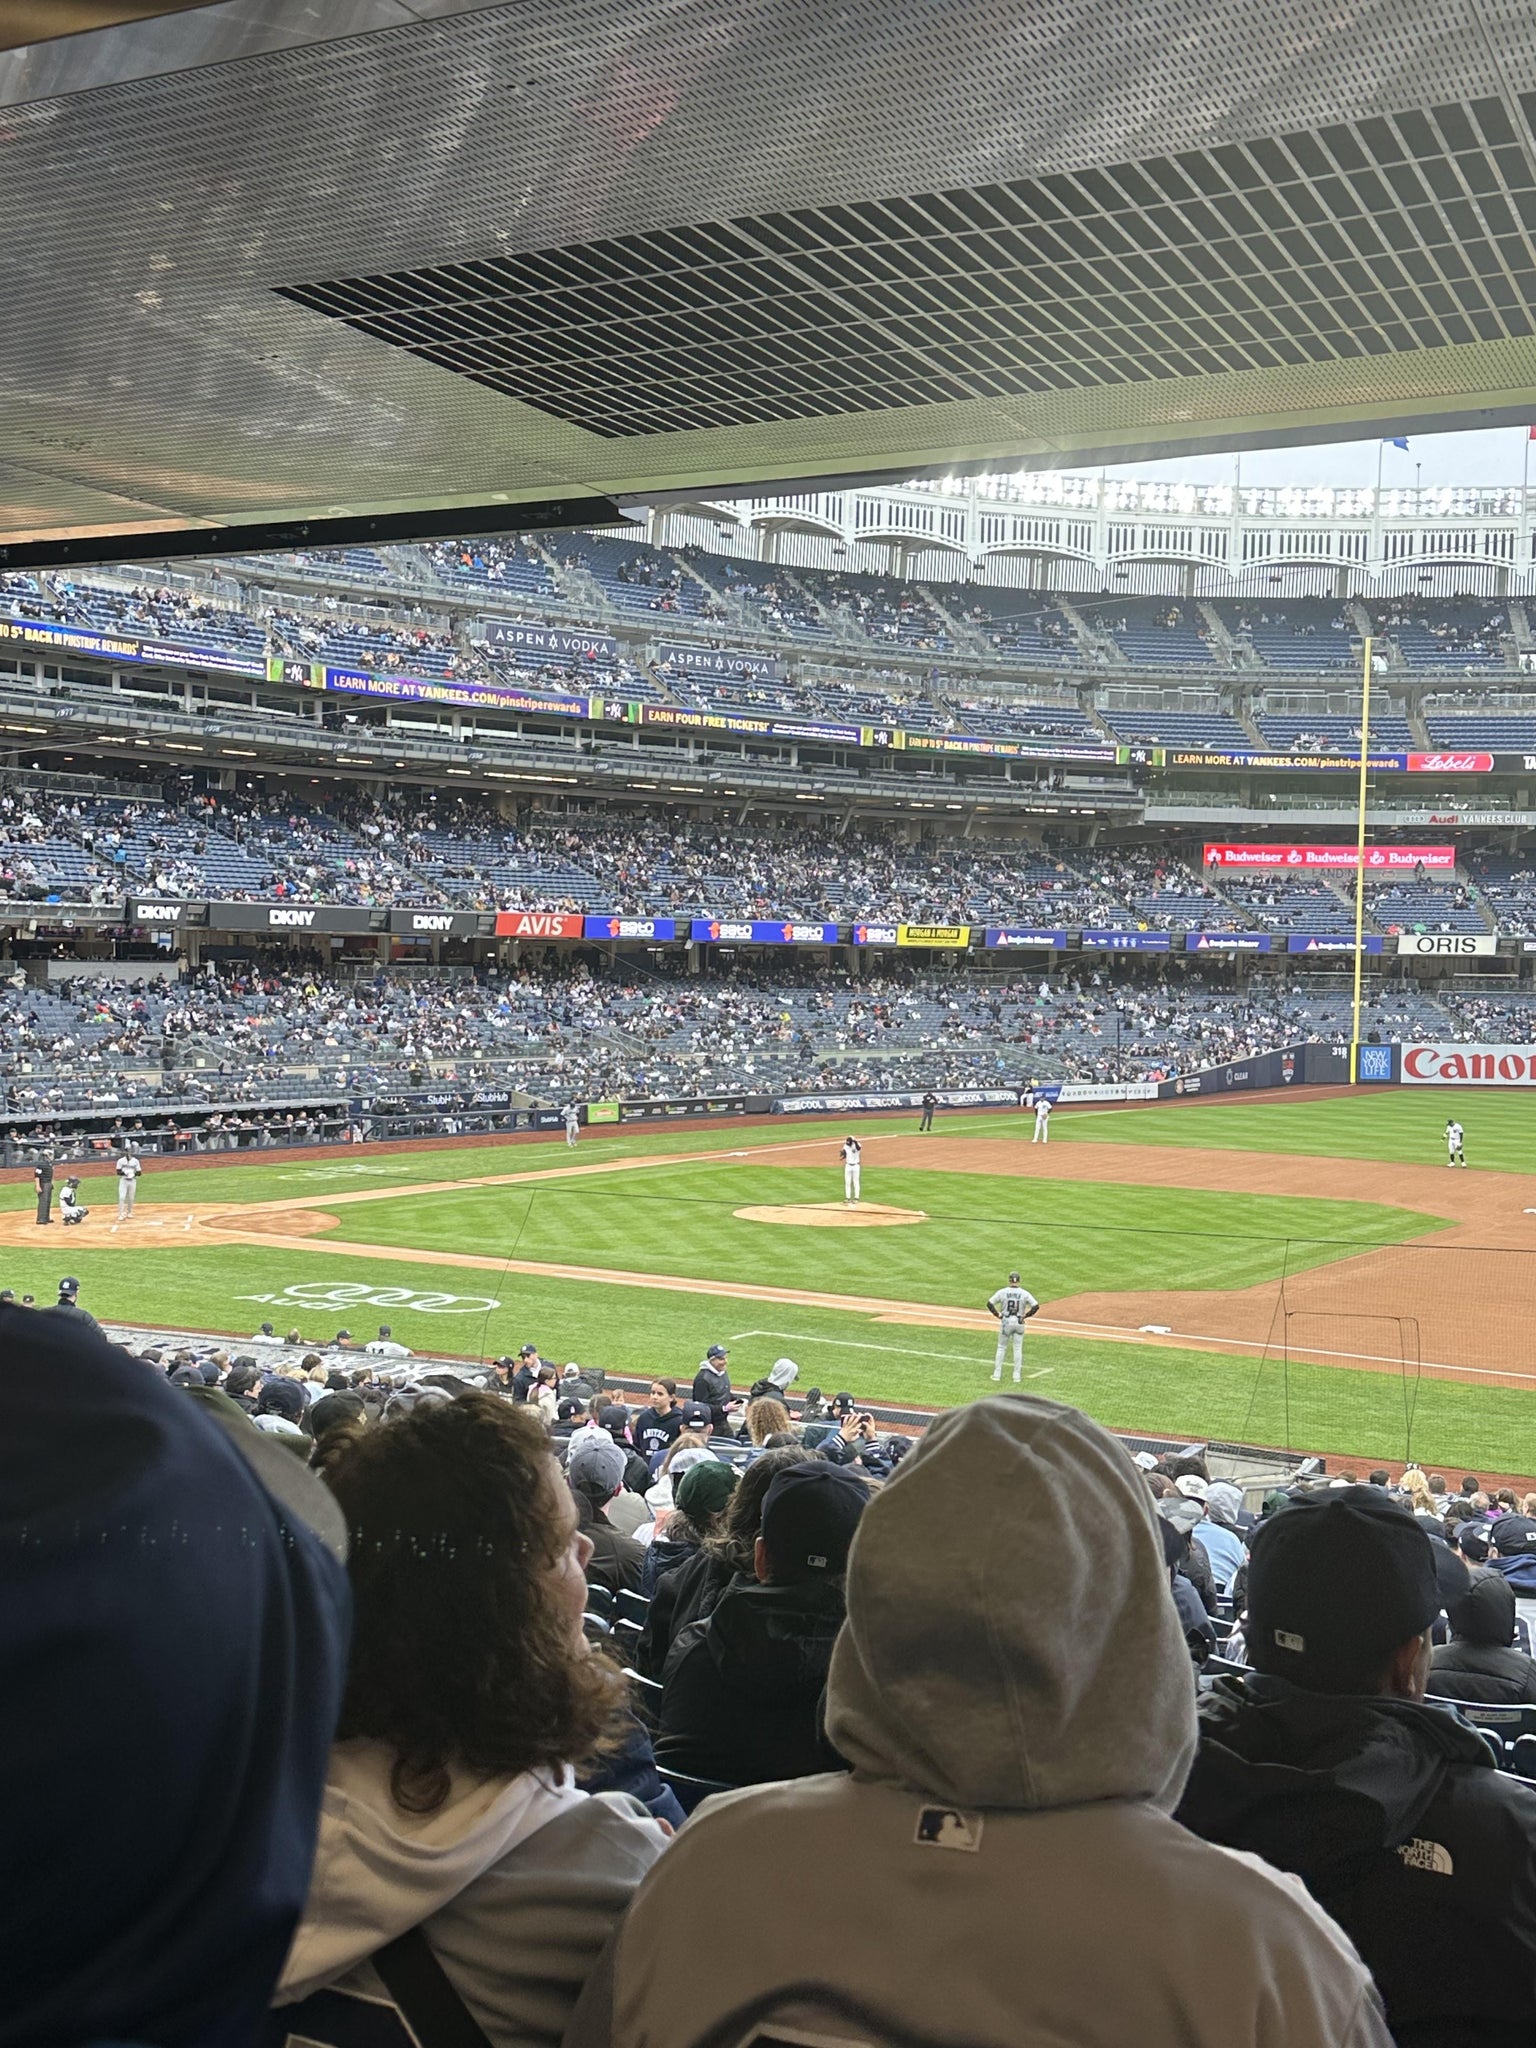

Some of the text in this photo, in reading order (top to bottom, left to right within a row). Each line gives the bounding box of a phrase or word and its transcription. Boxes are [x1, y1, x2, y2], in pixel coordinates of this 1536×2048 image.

[25, 628, 53, 644] BACK
[63, 634, 101, 651] PINSTRIPE
[495, 628, 609, 654] ASPEN VODKA
[667, 651, 769, 674] ASPEN VODKA
[333, 674, 366, 692] LEARN
[368, 678, 400, 695] MORE
[402, 684, 416, 696] AT
[648, 710, 674, 723] EARN
[676, 712, 701, 725] FOUR
[703, 715, 726, 729] FREE
[1172, 755, 1202, 764] LEARN
[1204, 755, 1231, 765] MORE
[1233, 756, 1244, 765] AT
[1428, 814, 1527, 824] Audi YANKEES CLUB
[1225, 850, 1282, 863] Budweiser
[1306, 851, 1363, 864] Budweise
[1389, 852, 1451, 865] Budweiser
[137, 905, 181, 920] DKNY
[269, 909, 315, 926] DKNY
[413, 914, 454, 931] DKNY
[516, 915, 564, 936] AVIS
[1416, 937, 1477, 953] ORIS
[1331, 1047, 1347, 1056] 318
[1365, 1050, 1386, 1060] NEW
[1362, 1058, 1389, 1069] YORK
[1234, 1072, 1249, 1081] CLEAR
[1365, 1066, 1385, 1076] LIFE
[842, 1099, 865, 1108] COOL
[882, 1098, 903, 1107] COOL
[962, 1094, 983, 1102] COOL
[1000, 1093, 1018, 1101] COOL
[800, 1100, 824, 1109] COOL
[231, 1293, 358, 1312] Audi
[1411, 1838, 1435, 1851] THE
[1404, 1854, 1435, 1870] FACE
